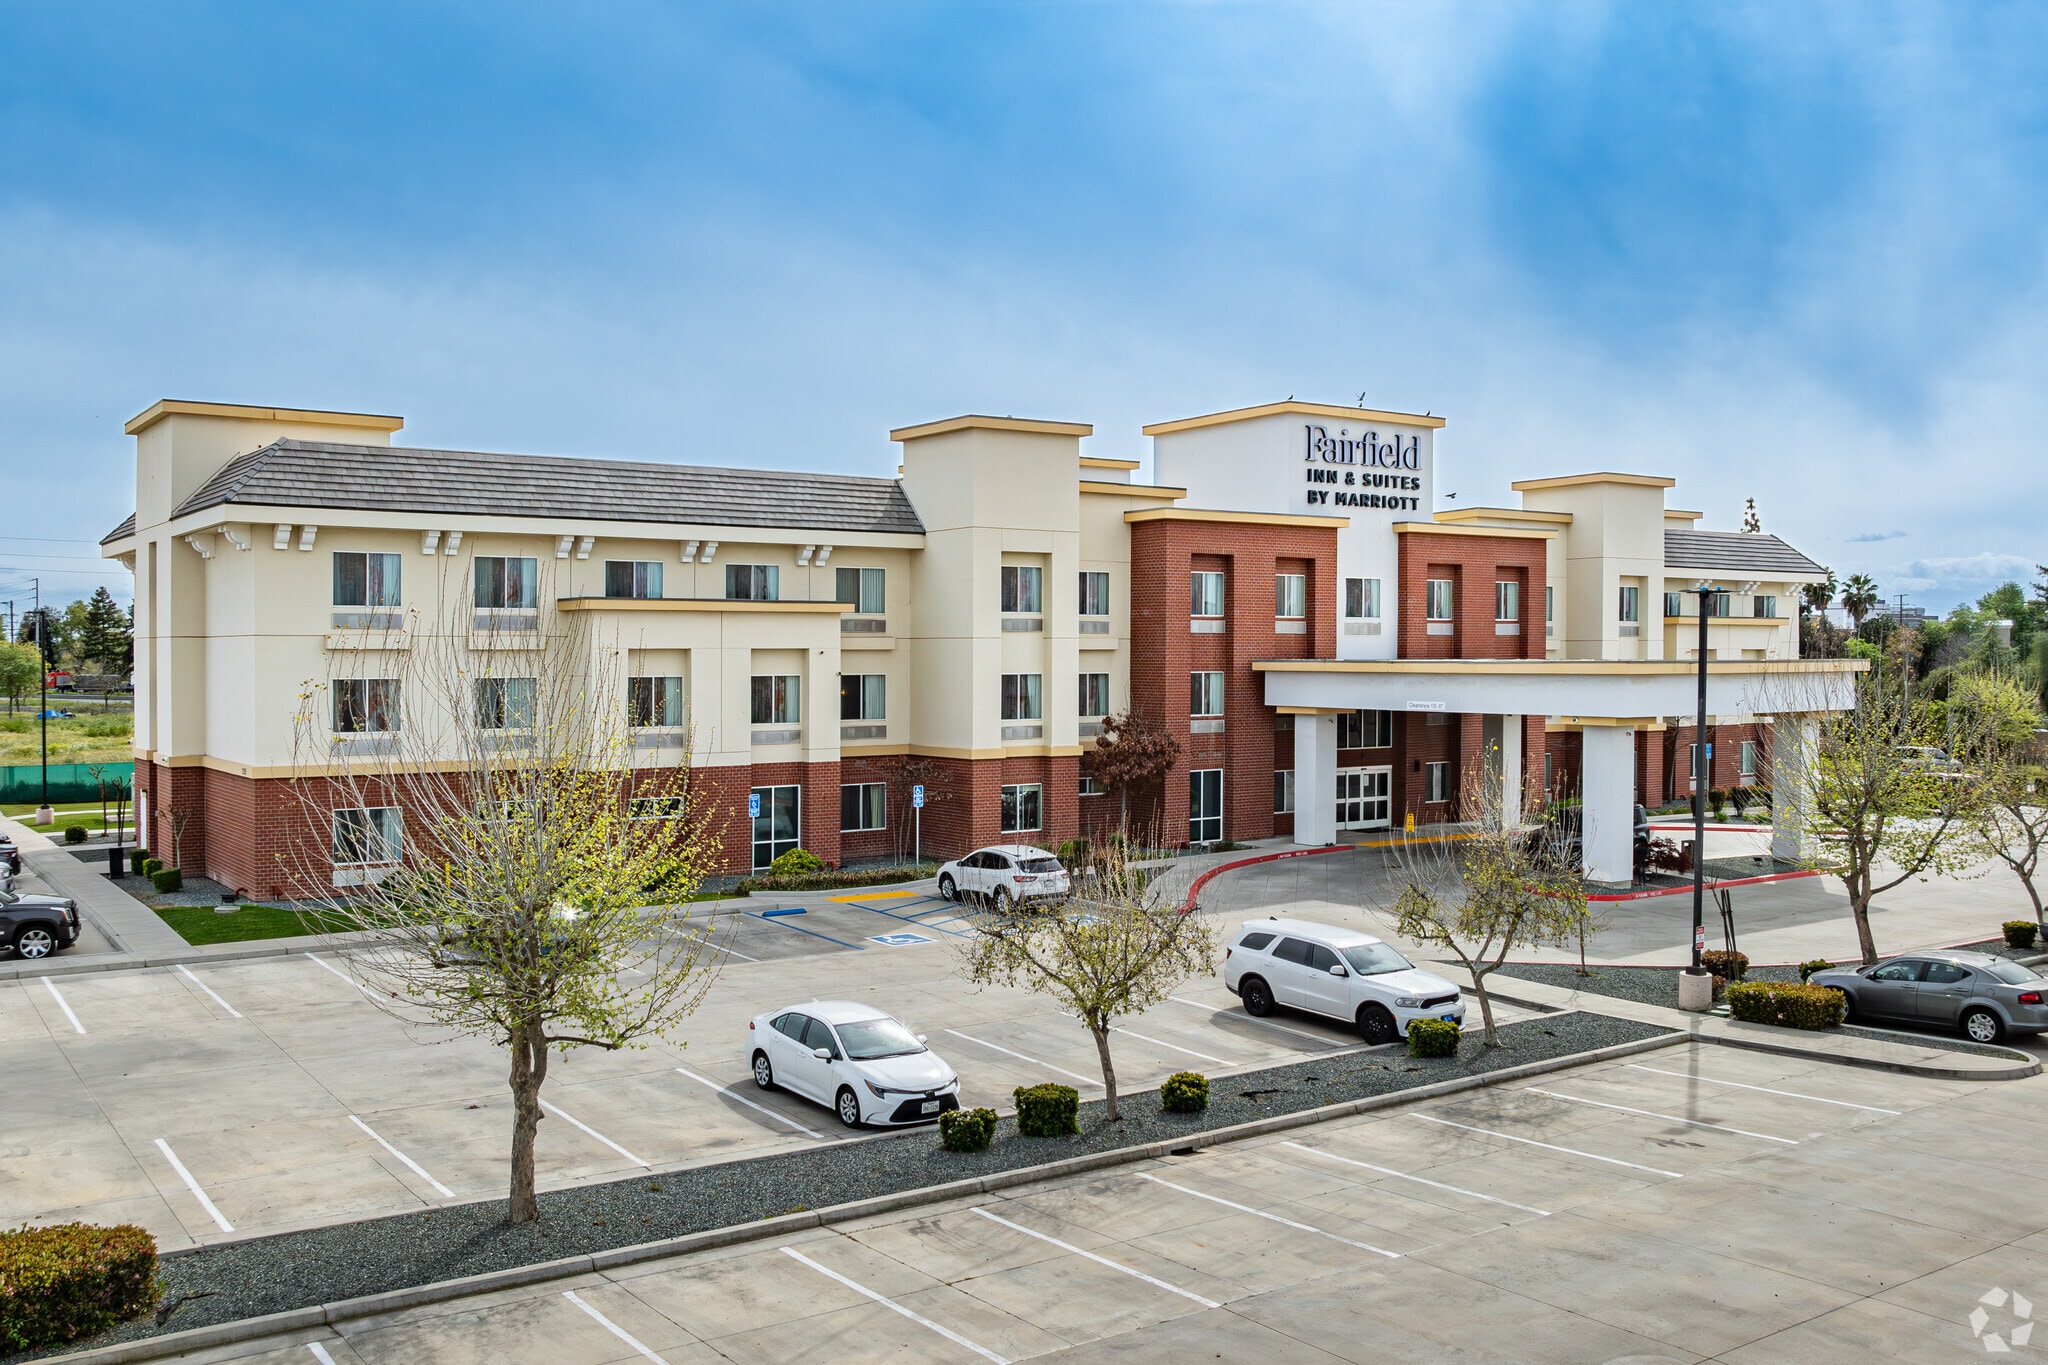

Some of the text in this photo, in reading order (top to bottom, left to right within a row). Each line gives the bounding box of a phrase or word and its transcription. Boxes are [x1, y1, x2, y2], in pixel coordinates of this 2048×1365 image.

[1305, 424, 1422, 470] Fairfield
[1307, 468, 1420, 491] INN & SUITES
[1307, 489, 1419, 511] BY MARRIOTT
